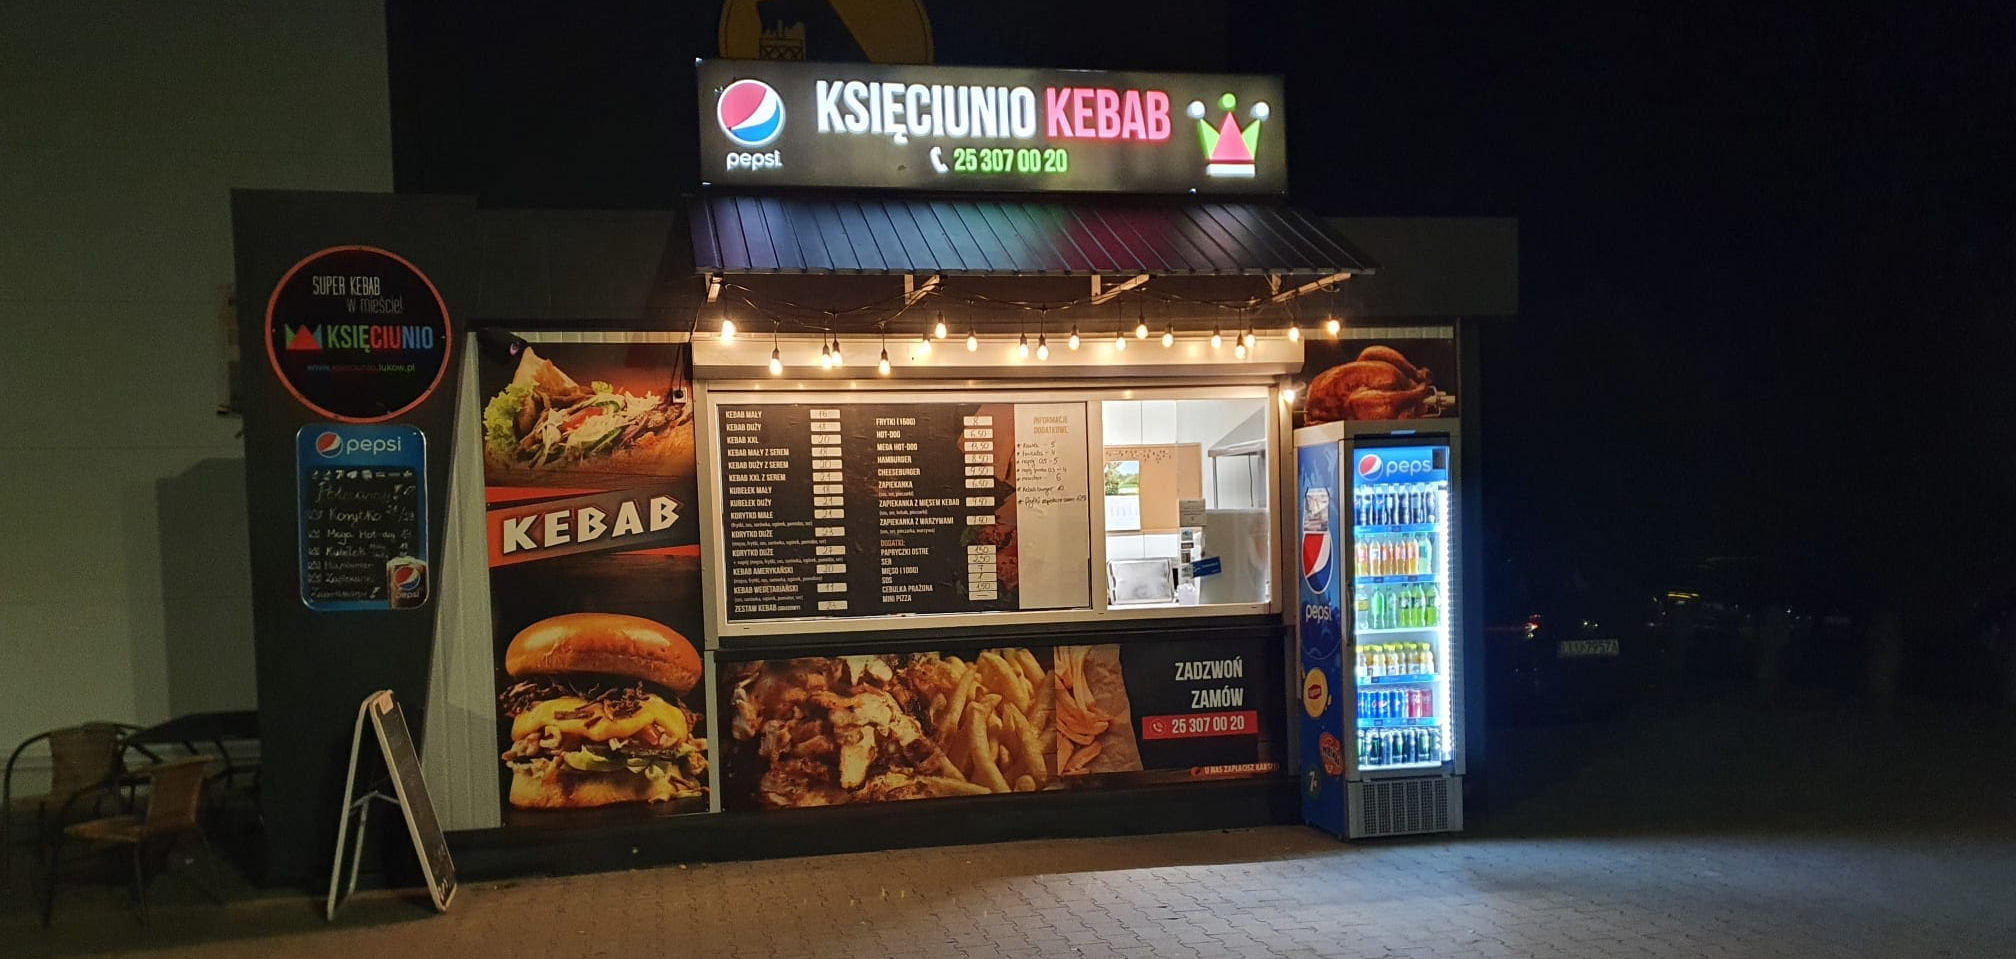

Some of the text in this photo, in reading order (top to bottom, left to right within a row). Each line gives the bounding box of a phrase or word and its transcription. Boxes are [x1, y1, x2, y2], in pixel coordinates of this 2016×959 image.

[815, 80, 1172, 145] KSIĘCIUNIO KEBAB
[726, 150, 784, 172] pepsi
[953, 148, 1068, 173] 25 307 00 20
[312, 276, 381, 296] SUPER KEBAB
[327, 325, 434, 353] KSIĘCIUNIO
[746, 410, 762, 418] MAŁY
[876, 418, 896, 426] FRYTKI
[1033, 416, 1068, 424] INFORMACJE
[726, 422, 762, 432] KEBAB DUŻY
[1033, 426, 1069, 434] DODATKOWE
[877, 430, 900, 438] HOT-DOG
[727, 436, 746, 444] KEBAB
[346, 436, 401, 456] pepsi
[894, 443, 918, 451] HOT-DOG
[748, 448, 763, 456] MAŁY
[770, 448, 790, 456] SEREM
[749, 460, 764, 468] DUŻY
[878, 456, 912, 464] HAMBURGER
[1386, 458, 1432, 477] peps
[878, 468, 920, 476] CHEESEBURGER
[729, 474, 748, 482] KEBAB
[878, 480, 913, 488] ZAPIEKANKA
[756, 486, 772, 494] MAŁY
[756, 498, 772, 507] DUŻY
[880, 500, 914, 508] ZAPIEKANKA
[942, 498, 960, 506] KEBAB
[731, 512, 757, 520] KORYTKO
[503, 494, 680, 554] KEBAB
[880, 518, 914, 526] ZAPIEKANKA
[920, 516, 954, 524] WARZYWAMI
[732, 529, 774, 538] KORYTKO DUŻE
[760, 548, 774, 556] DUŻE
[881, 558, 892, 566] SER
[733, 566, 794, 576] KEBAB AMERYKAŃSKI
[882, 568, 898, 576] MIĘSO
[882, 576, 892, 584] SOS
[734, 586, 753, 594] KEBAB
[882, 584, 934, 594] CEBULKA PRAŻONA
[896, 594, 912, 602] PIZZA
[758, 604, 776, 612] KEBAB
[1305, 604, 1332, 624] pepsi
[1175, 655, 1243, 681] ZADZWOŃ
[1191, 685, 1244, 709] ZAMÓW
[1189, 717, 1210, 733] 307
[1213, 716, 1228, 731] 00
[1230, 715, 1245, 730] 20
